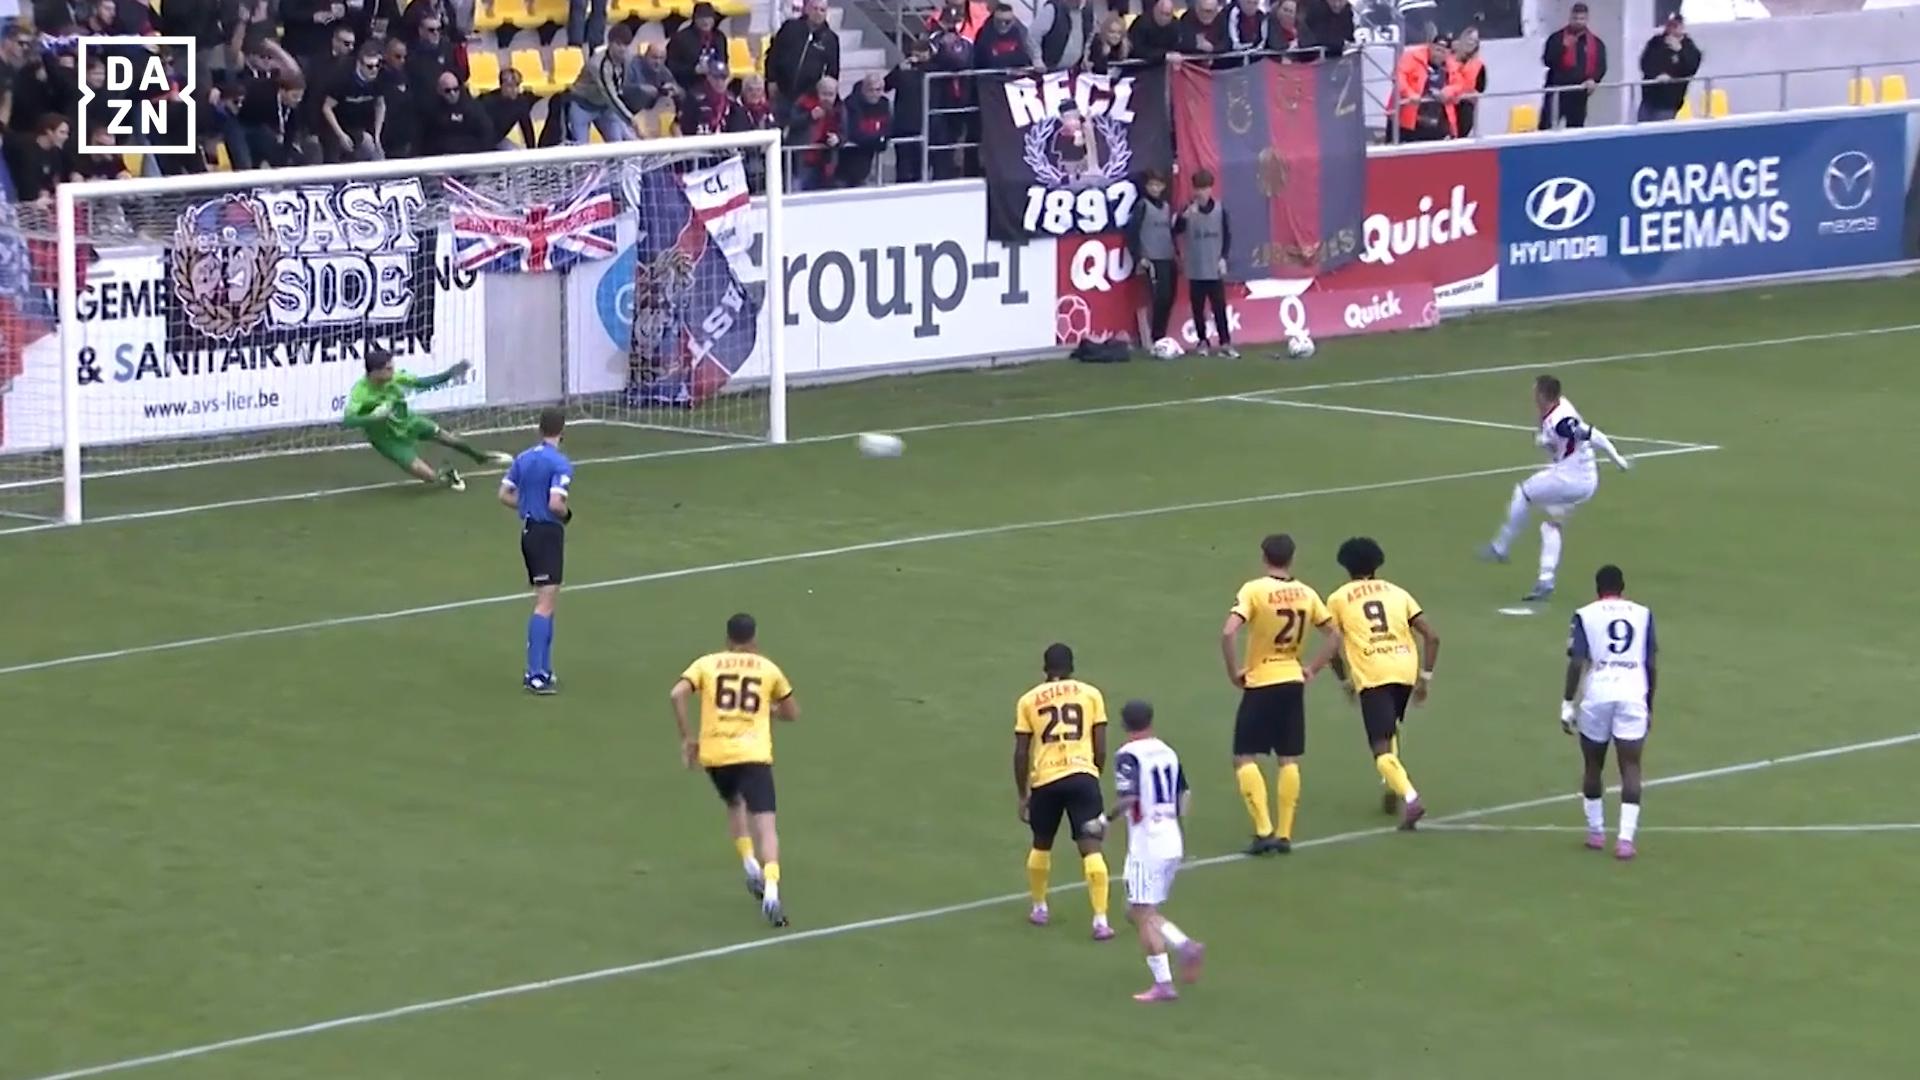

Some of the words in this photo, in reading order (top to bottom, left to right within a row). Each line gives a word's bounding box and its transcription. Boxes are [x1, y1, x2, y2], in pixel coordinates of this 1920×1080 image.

[1004, 70, 1136, 128] RFCL
[1630, 156, 1780, 209] GARAGE
[256, 179, 426, 252] EAST
[1023, 180, 1138, 234] 1897
[1359, 184, 1478, 265] Quick
[1619, 200, 1790, 255] LEEMANS
[1509, 235, 1608, 265] HYUNDAI
[265, 252, 414, 328] SIDE
[1344, 290, 1402, 329] Quick
[77, 346, 104, 386] &
[143, 389, 279, 419] www.avs-lier.be
[1274, 608, 1306, 645] 21
[1362, 600, 1388, 634] 9
[1607, 619, 1635, 654] 9
[715, 674, 762, 713] 66
[1037, 703, 1083, 744] 29
[1152, 765, 1174, 804] 11
